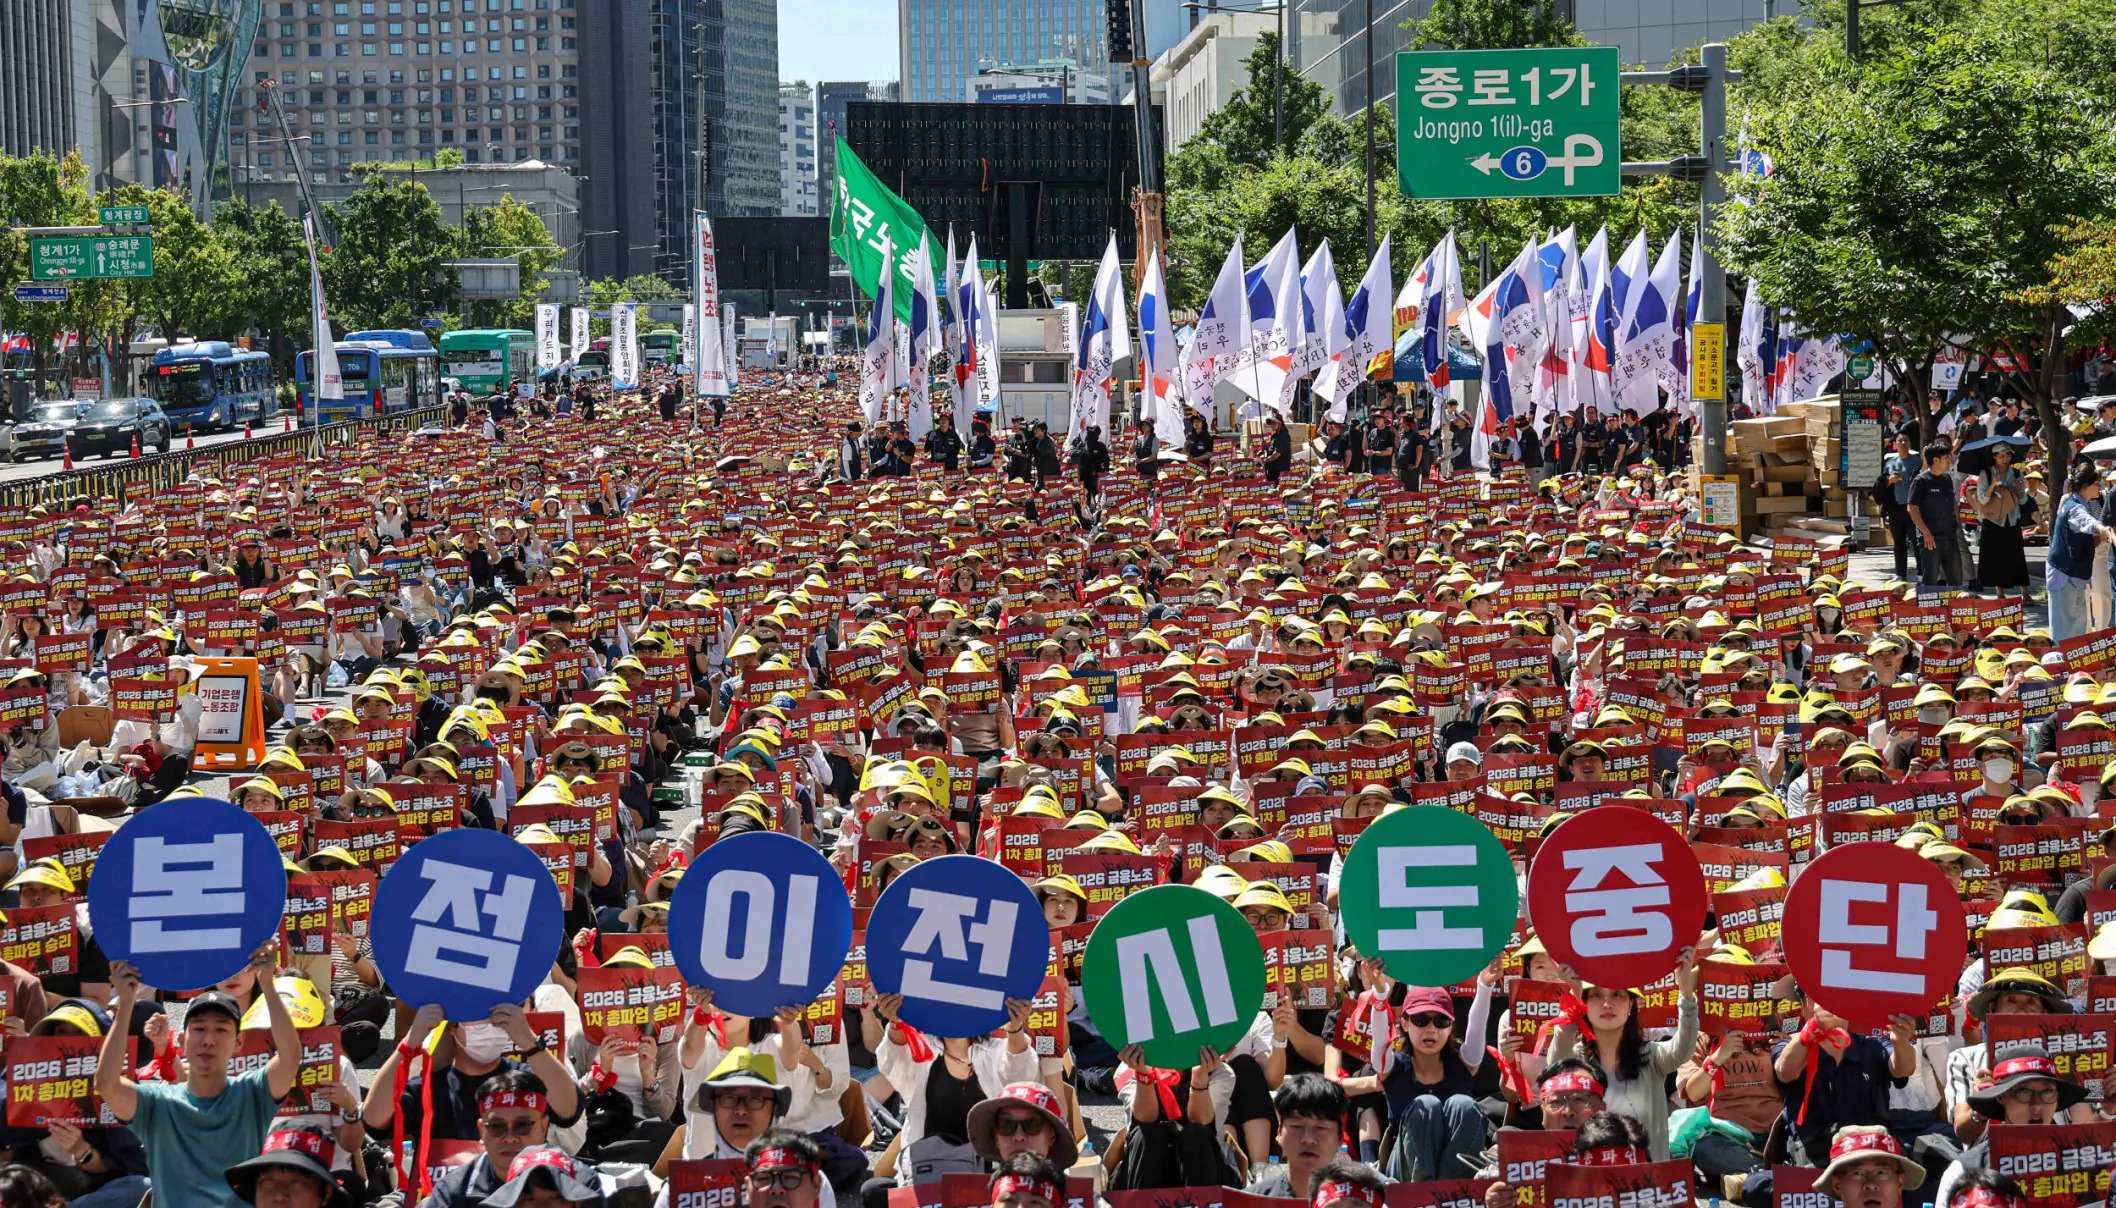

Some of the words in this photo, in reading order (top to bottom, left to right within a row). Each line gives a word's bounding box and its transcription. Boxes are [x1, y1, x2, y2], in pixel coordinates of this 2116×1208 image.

[1414, 63, 1596, 108] 종로1가
[1414, 116, 1483, 144] Jongno
[1490, 114, 1553, 142] 1(il)-ga
[1516, 151, 1532, 175] 6
[104, 210, 142, 220] 청계광장
[40, 245, 80, 256] 청계1가
[108, 240, 140, 250] 숭례문
[109, 259, 130, 270] 시청
[620, 309, 631, 384] 산림조합중앙회지부
[1699, 340, 1707, 361] 공사중
[1710, 340, 1719, 375] 서소문고가
[347, 363, 360, 371] 706
[1710, 378, 1718, 392] 철거
[231, 620, 257, 628] 금융노조
[220, 629, 240, 637] 총파업
[39, 645, 60, 654] 2026
[62, 641, 87, 651] 금융노조
[1626, 651, 1647, 659] 2026
[1650, 648, 1676, 658] 금융노조
[52, 652, 72, 662] 총파업
[75, 650, 86, 658] 승리
[836, 661, 856, 675] 2026
[857, 652, 883, 667] 금융노조
[1496, 659, 1518, 669] 2026
[1521, 655, 1548, 666] 금융노조
[1638, 660, 1660, 669] 총파업
[1663, 659, 1676, 668] 승리
[1534, 666, 1548, 675] 승리
[751, 682, 773, 692] 2026
[776, 678, 805, 689] 금융노조
[947, 684, 969, 693] 2026
[972, 680, 998, 691] 금융노조
[1416, 676, 1439, 686] 2026
[1442, 672, 1465, 685] 금융노조
[117, 691, 141, 699] 2026
[144, 689, 173, 699] 금융노조
[201, 689, 241, 700] 기업은행
[960, 692, 982, 702] 총파업
[985, 690, 999, 699] 승리
[1428, 686, 1449, 694] 총파업
[14, 695, 43, 707] 금융노조
[117, 701, 128, 709] 1차
[131, 701, 154, 709] 총파업
[157, 700, 173, 709] 승리
[1609, 691, 1637, 705] 2026
[1638, 696, 1667, 712] 금융노조
[2, 709, 25, 721] 총파업
[29, 706, 44, 715] 승리
[828, 708, 855, 720] 금융노조
[1649, 712, 1663, 723] 승리
[841, 719, 855, 730] 승리
[1240, 740, 1265, 752] 2026
[1488, 768, 1516, 780] 2026
[1519, 764, 1553, 777] 금융노조
[1504, 779, 1532, 791] 총파업
[1536, 777, 1553, 788] 승리
[413, 796, 453, 810] 금융노조
[1828, 798, 1858, 814] 2026
[1917, 792, 1957, 808] 금융노조
[432, 810, 453, 822] 승리
[1146, 802, 1177, 815] 2026
[1938, 806, 1958, 819] 승리
[1146, 817, 1161, 829] 1차
[1164, 814, 1194, 827] 총파업
[1289, 812, 1319, 825] 2026
[549, 819, 590, 837] 금융노조
[353, 831, 395, 848] 금융노조
[568, 833, 589, 846] 승리
[1834, 832, 1868, 846] 2026
[1999, 843, 2034, 856] 2026
[2039, 838, 2080, 853] 금융노조
[374, 845, 396, 859] 승리
[2000, 860, 2015, 872] 1차
[2020, 856, 2054, 870] 총파업
[2060, 853, 2081, 866] 승리
[1107, 869, 1154, 887] 금융노조
[128, 833, 246, 954] 본
[1089, 887, 1125, 902] 총파업
[1286, 892, 1310, 909] 승리
[1377, 845, 1484, 951] 도
[1562, 843, 1673, 958] 중
[404, 858, 536, 993] 점
[1722, 911, 1757, 928] 2026
[21, 917, 71, 940] 금융노조
[700, 869, 819, 987] 이
[1725, 930, 1740, 947] 1차
[1744, 921, 1781, 942] 총파업
[45, 936, 70, 952] 승리
[1818, 879, 1938, 995] 단
[899, 887, 1020, 1011] 전
[1990, 947, 2033, 963] 2026
[2038, 937, 2084, 960] 금융노조
[1301, 963, 1327, 981] 승리
[2061, 956, 2086, 973] 승리
[1116, 914, 1238, 1044] 시
[584, 990, 624, 1007] 2026
[628, 982, 681, 1005] 금융노조
[1704, 984, 1748, 998] 2026
[585, 1011, 603, 1026] 1차
[607, 1006, 649, 1026] 총파업
[653, 1001, 680, 1020] 승리
[807, 1000, 835, 1019] 승리
[1516, 1002, 1562, 1018] 2026
[1704, 1001, 1724, 1016] 1차
[1729, 1001, 1772, 1018] 총파업
[1028, 1011, 1057, 1029] 승리
[1516, 1019, 1536, 1034] 1차
[2048, 1031, 2107, 1053] 금융노조
[2076, 1053, 2106, 1071] 승리
[14, 1061, 60, 1080] 2026
[14, 1085, 34, 1102] 1차
[38, 1079, 87, 1101] 총파업
[482, 1092, 537, 1111] 총파업
[265, 1131, 321, 1152] 총파업
[1842, 1133, 1895, 1152] 총파업
[1582, 1147, 1638, 1164] 총파업
[2000, 1153, 2056, 1174] 2026
[2034, 1173, 2088, 1197] 총파업
[679, 1188, 734, 1208] 2026
[1553, 1191, 1613, 1208] 2026
[1620, 1181, 1687, 1208] 금융노조
[1781, 1193, 1828, 1208] 2026
